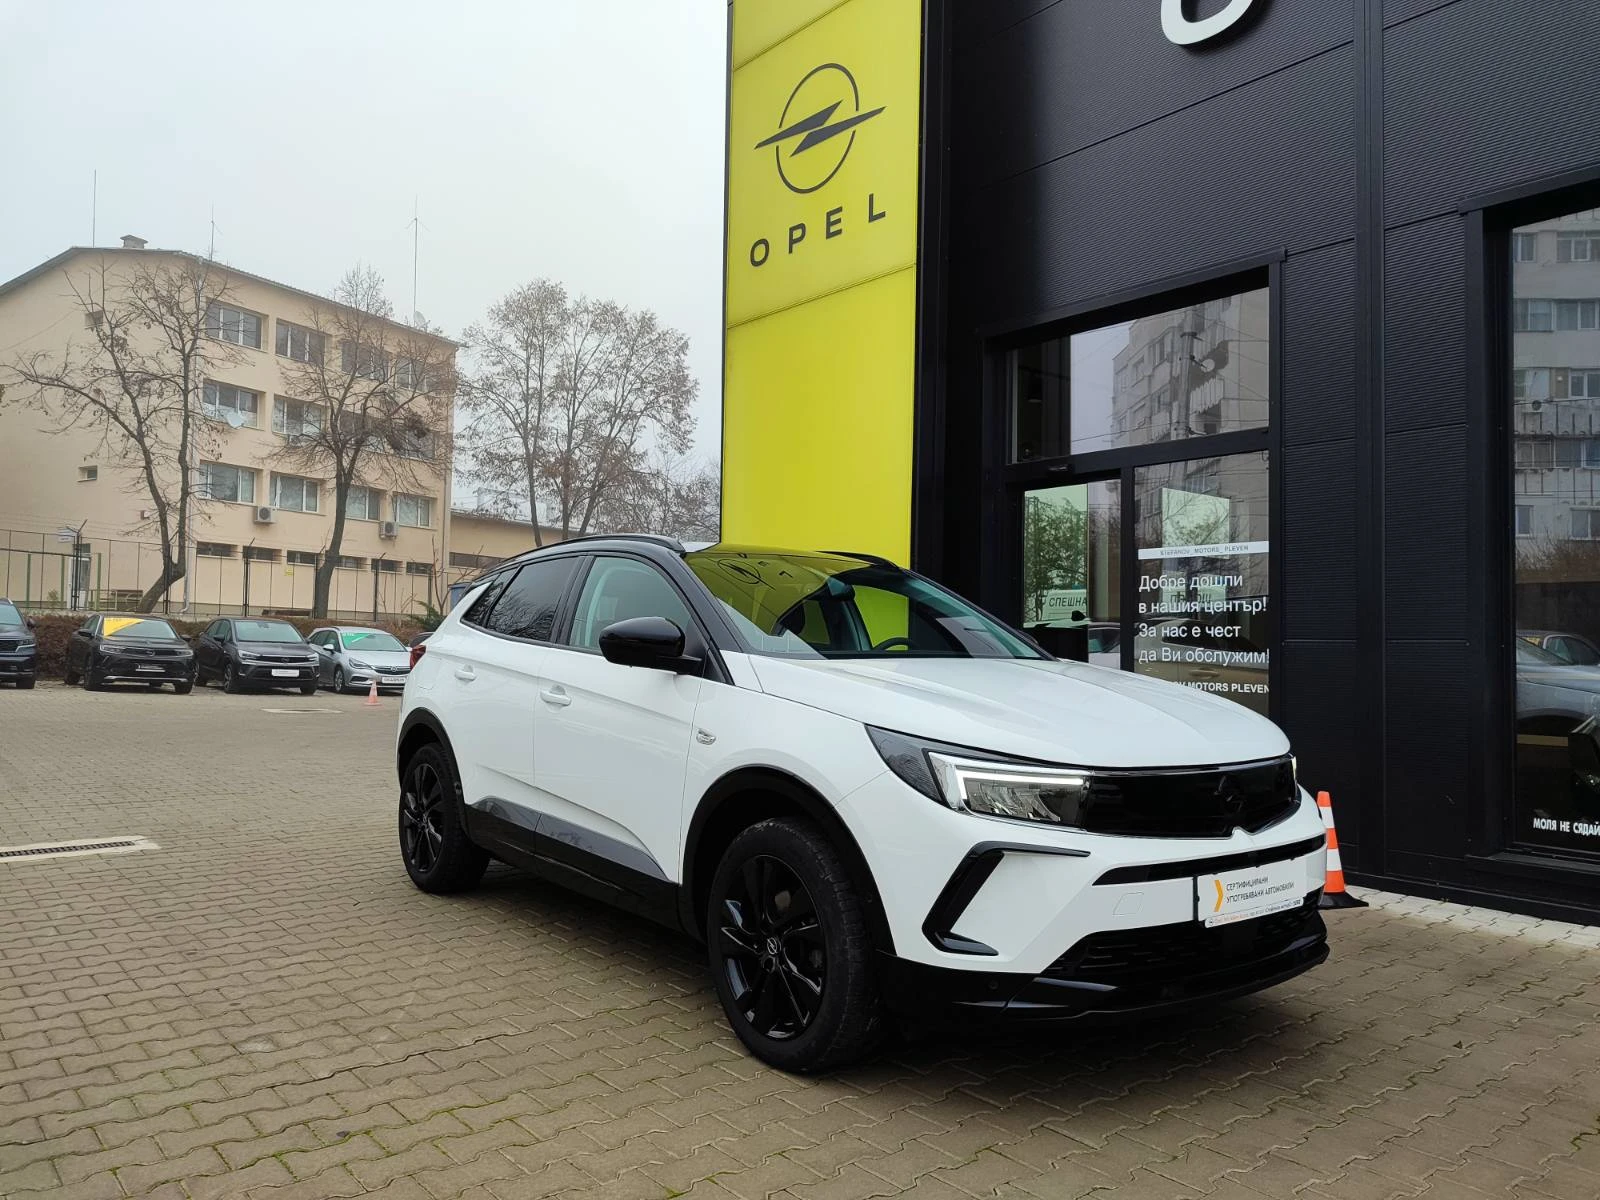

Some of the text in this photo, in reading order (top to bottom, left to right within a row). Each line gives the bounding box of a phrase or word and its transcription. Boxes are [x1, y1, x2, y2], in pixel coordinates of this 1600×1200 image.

[750, 193, 886, 267] OPEL
[1138, 575, 1243, 592] Добре дошли
[1049, 596, 1087, 607] СПЕШНА
[1138, 597, 1267, 615] в нашия център!
[1139, 623, 1241, 637] За нас е чест
[1138, 648, 1270, 667] да Ви обслужим!
[1533, 818, 1557, 831] МОЛЯ
[1560, 821, 1570, 832] НЕ
